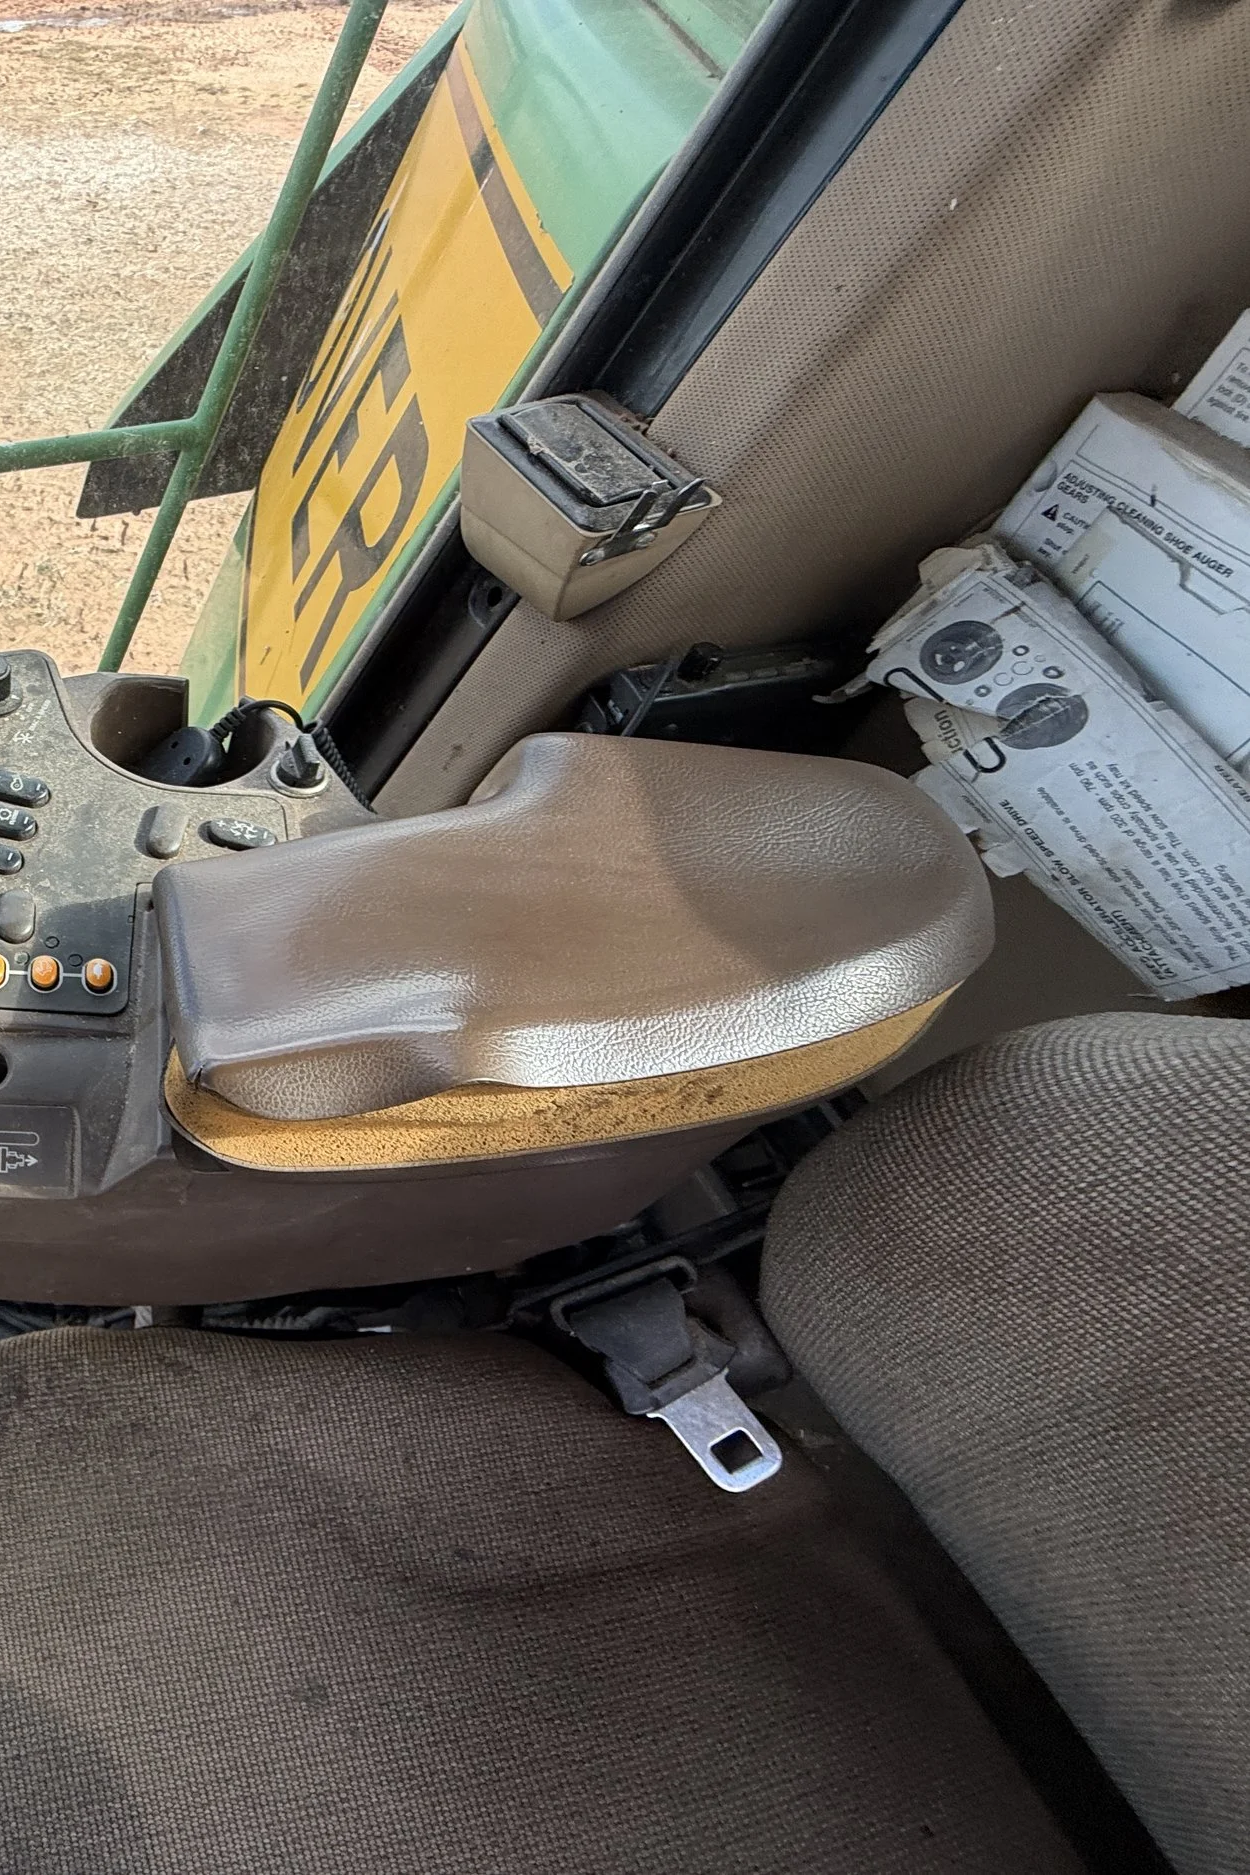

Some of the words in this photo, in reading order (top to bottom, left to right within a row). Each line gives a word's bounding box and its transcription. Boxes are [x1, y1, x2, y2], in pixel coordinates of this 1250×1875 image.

[1055, 481, 1090, 504] GEARS
[1062, 471, 1116, 506] ADJUSTING
[1113, 501, 1165, 536] CLEANING
[1161, 531, 1194, 553] SHOE
[1191, 550, 1234, 578] AUGER
[1067, 762, 1085, 775] rpm
[1084, 761, 1098, 769] as
[1104, 762, 1126, 777] may
[1092, 772, 1113, 788] such
[1117, 780, 1132, 788] kit
[1035, 787, 1066, 815] available
[1097, 798, 1116, 811] rpm
[1108, 789, 1132, 808] crops
[1126, 789, 1154, 811] speed
[998, 800, 1027, 825] DRIVE
[1109, 813, 1128, 827] 320
[1126, 810, 1160, 840] specialty
[1147, 813, 1168, 829] slow
[1066, 826, 1087, 842] drive
[1121, 828, 1136, 836] of
[1163, 832, 1182, 845] This
[1023, 827, 1055, 856] SPEED
[1131, 838, 1155, 856] range
[1163, 852, 1180, 865] use
[1051, 858, 1080, 884] SLOW
[1156, 868, 1174, 881] has
[1173, 867, 1190, 877] for
[1194, 868, 1216, 884] food
[1168, 883, 1190, 899] drive
[1210, 886, 1230, 900] and
[1183, 878, 1236, 929] recommended
[1076, 887, 1142, 954] ACCELERATOR
[1184, 901, 1212, 924] speed
[1110, 909, 1178, 978] (ATTACHMENT)
[1178, 932, 1200, 949] your
[1192, 951, 1214, 968] from
[1221, 945, 1240, 958] The
